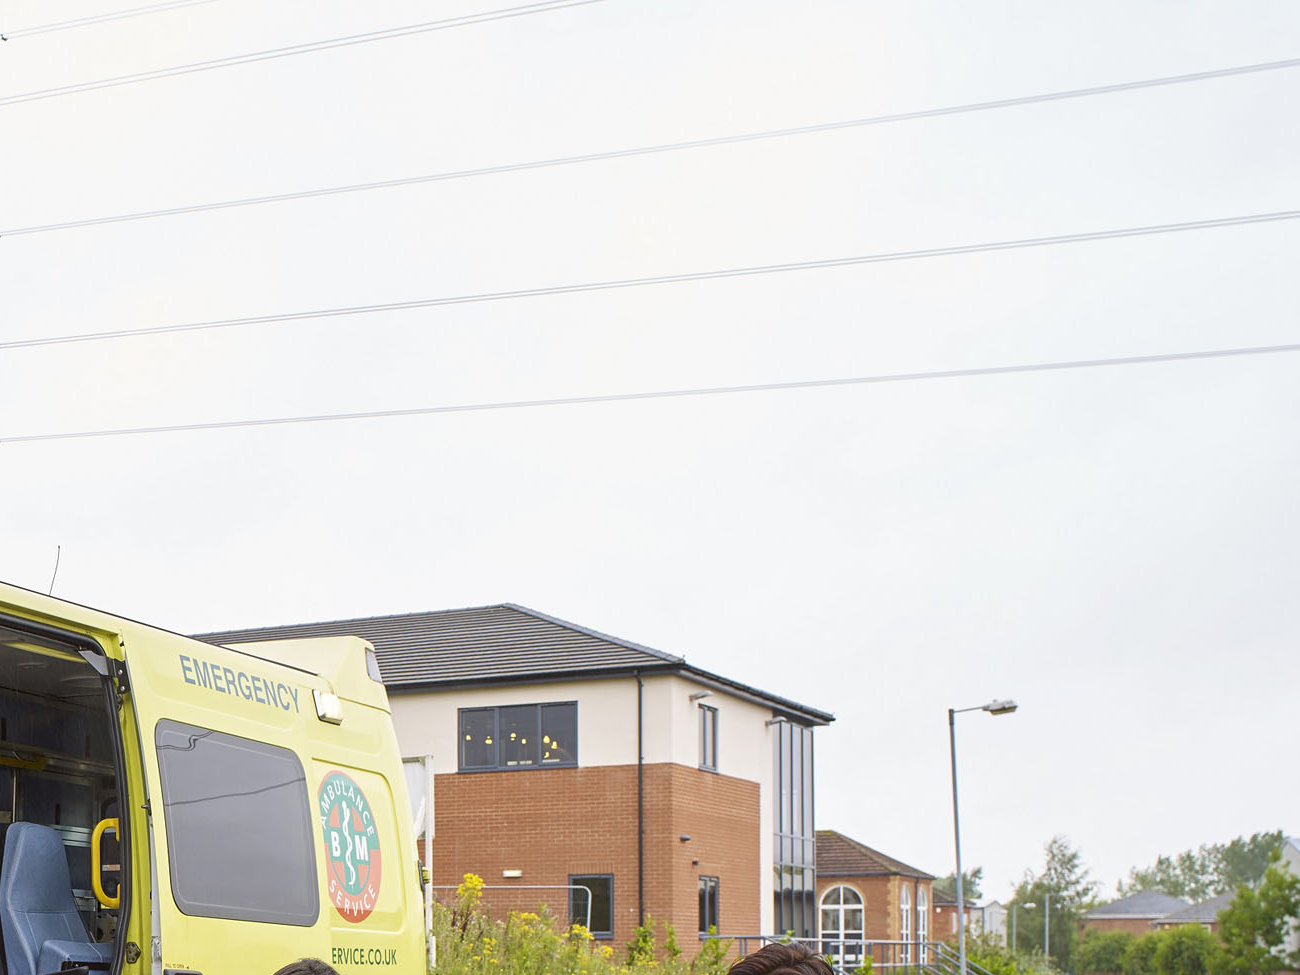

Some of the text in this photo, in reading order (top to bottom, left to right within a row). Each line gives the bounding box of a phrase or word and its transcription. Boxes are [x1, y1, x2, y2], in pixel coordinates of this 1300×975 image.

[179, 654, 300, 713] EMERGENCY
[321, 780, 375, 837] AMBULANCE
[329, 879, 376, 917] SERVICE
